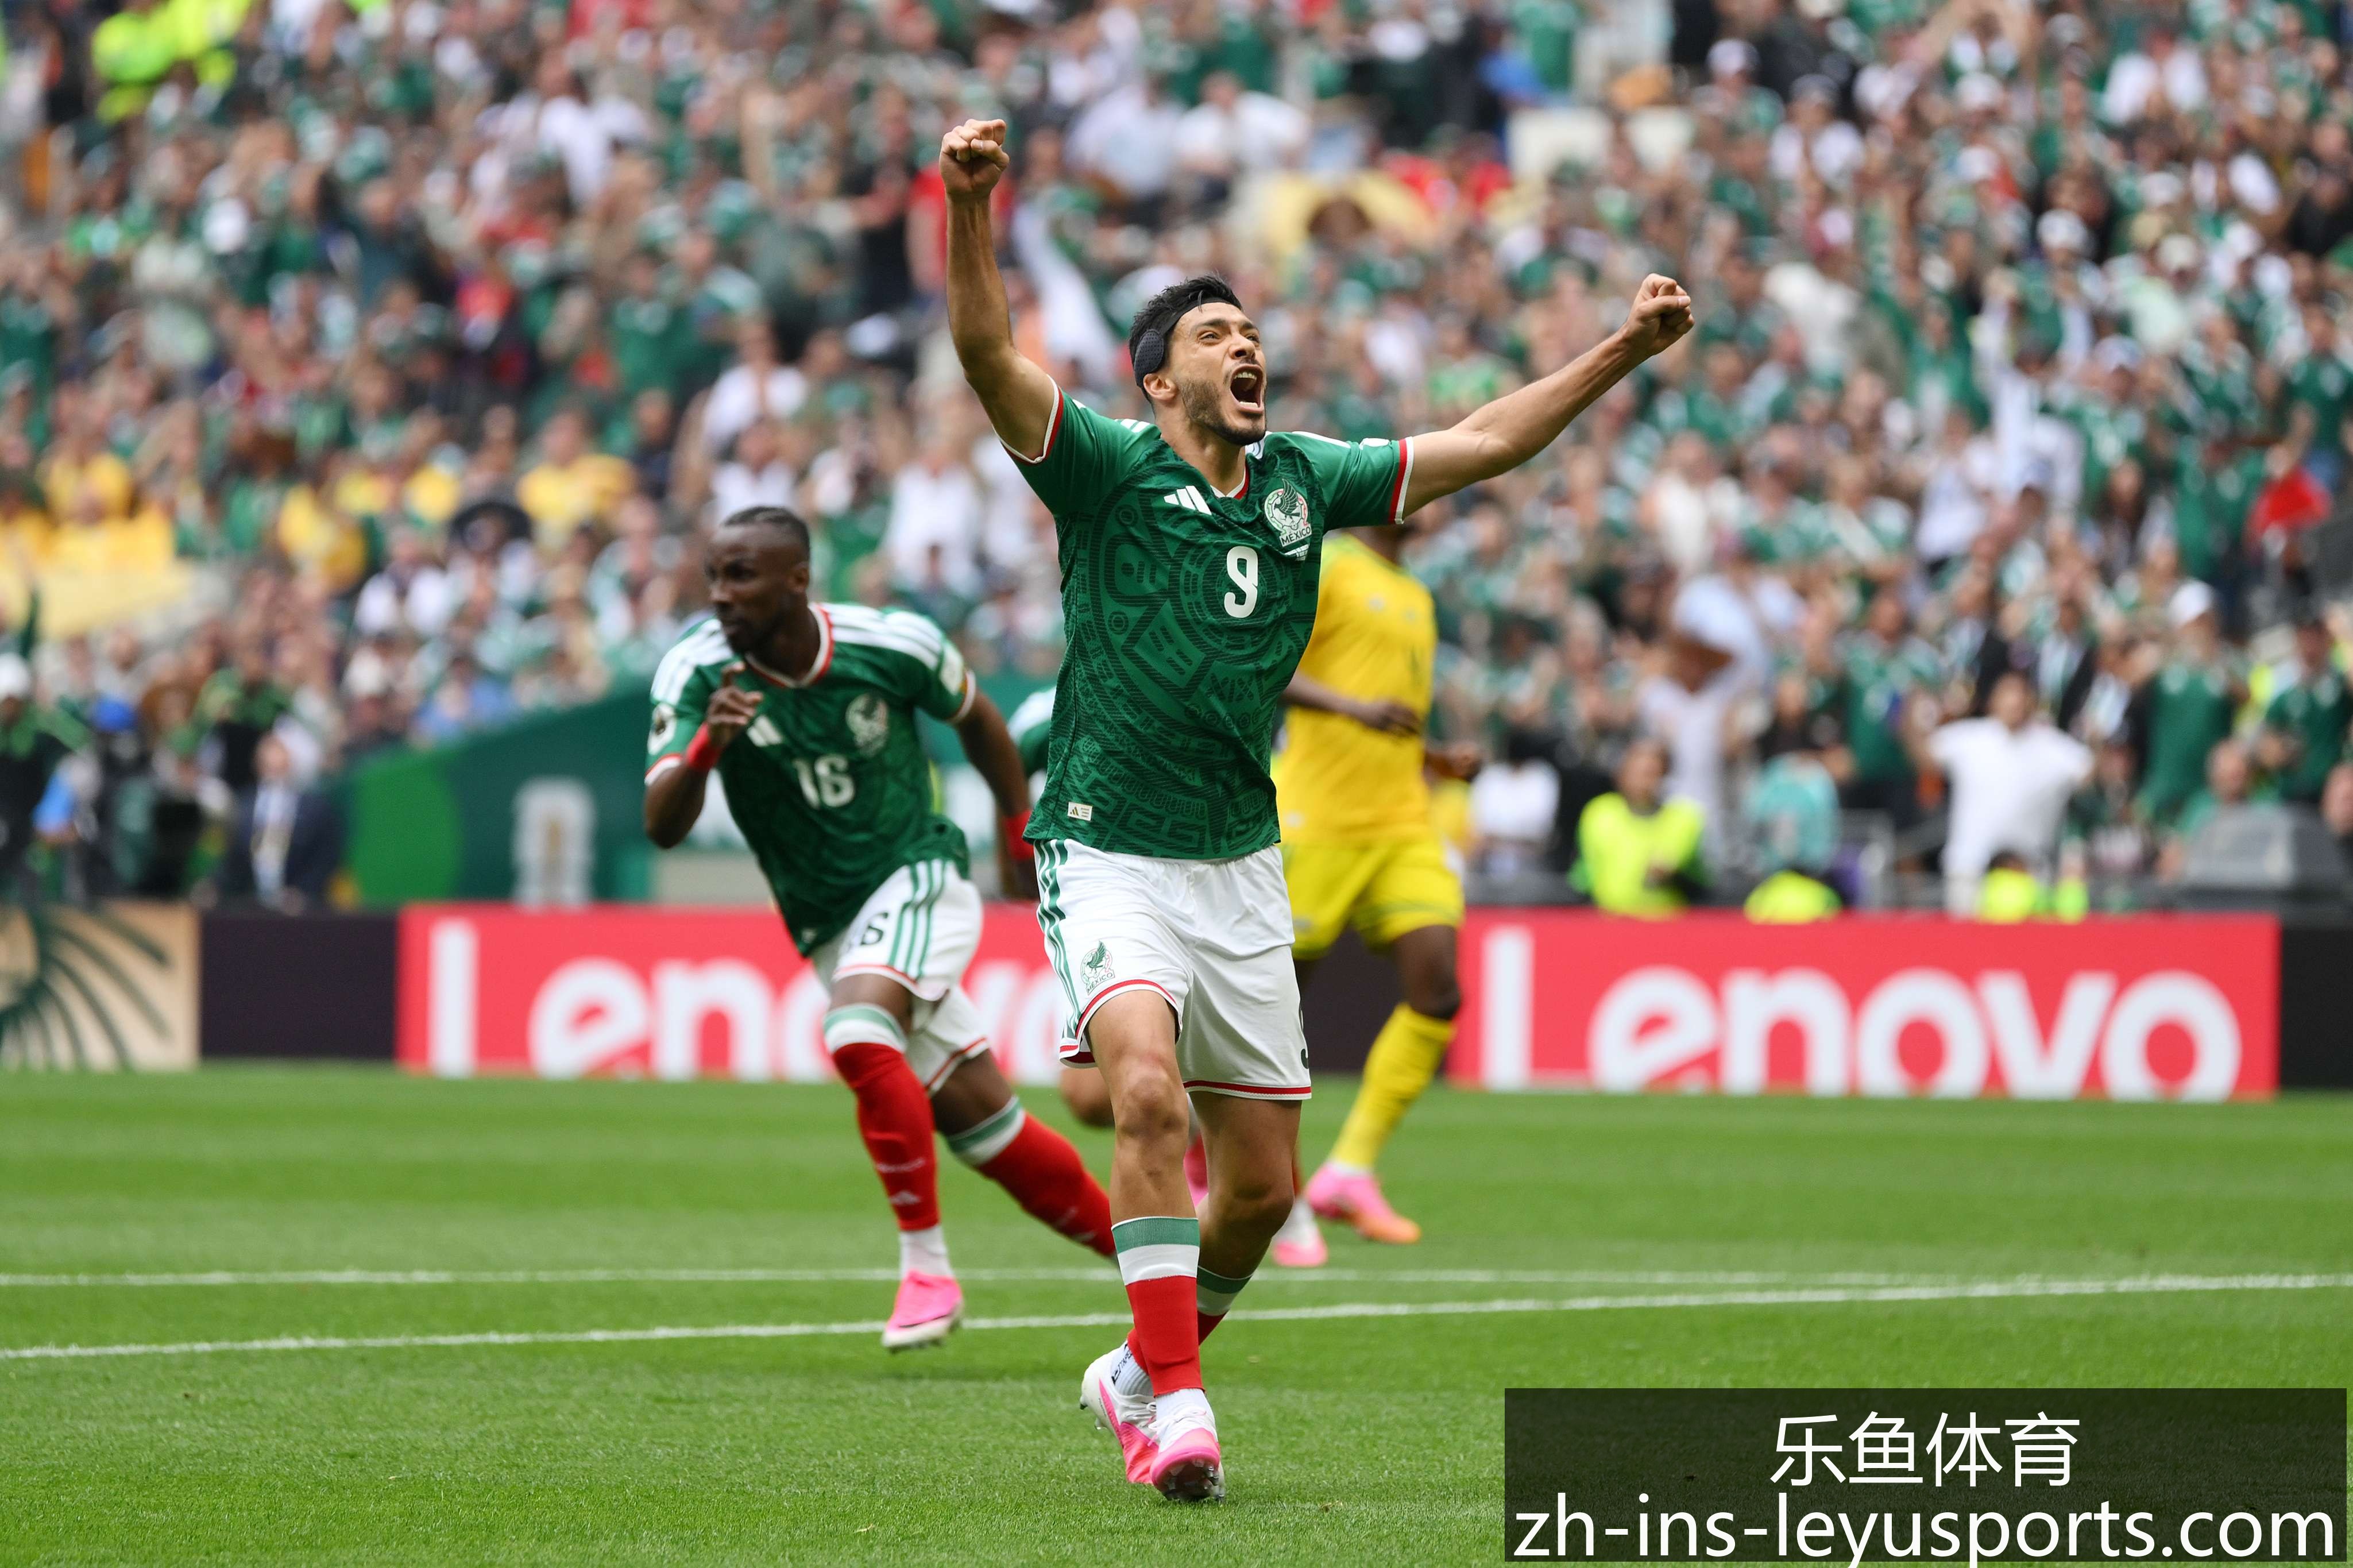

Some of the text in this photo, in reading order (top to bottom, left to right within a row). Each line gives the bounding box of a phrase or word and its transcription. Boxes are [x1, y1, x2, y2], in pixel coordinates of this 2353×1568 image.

[1280, 526, 1311, 546] MÉXICO
[1224, 546, 1258, 618] 9
[792, 755, 856, 810] 16
[429, 919, 1069, 1082] Len
[1482, 925, 2242, 1101] Lenovo
